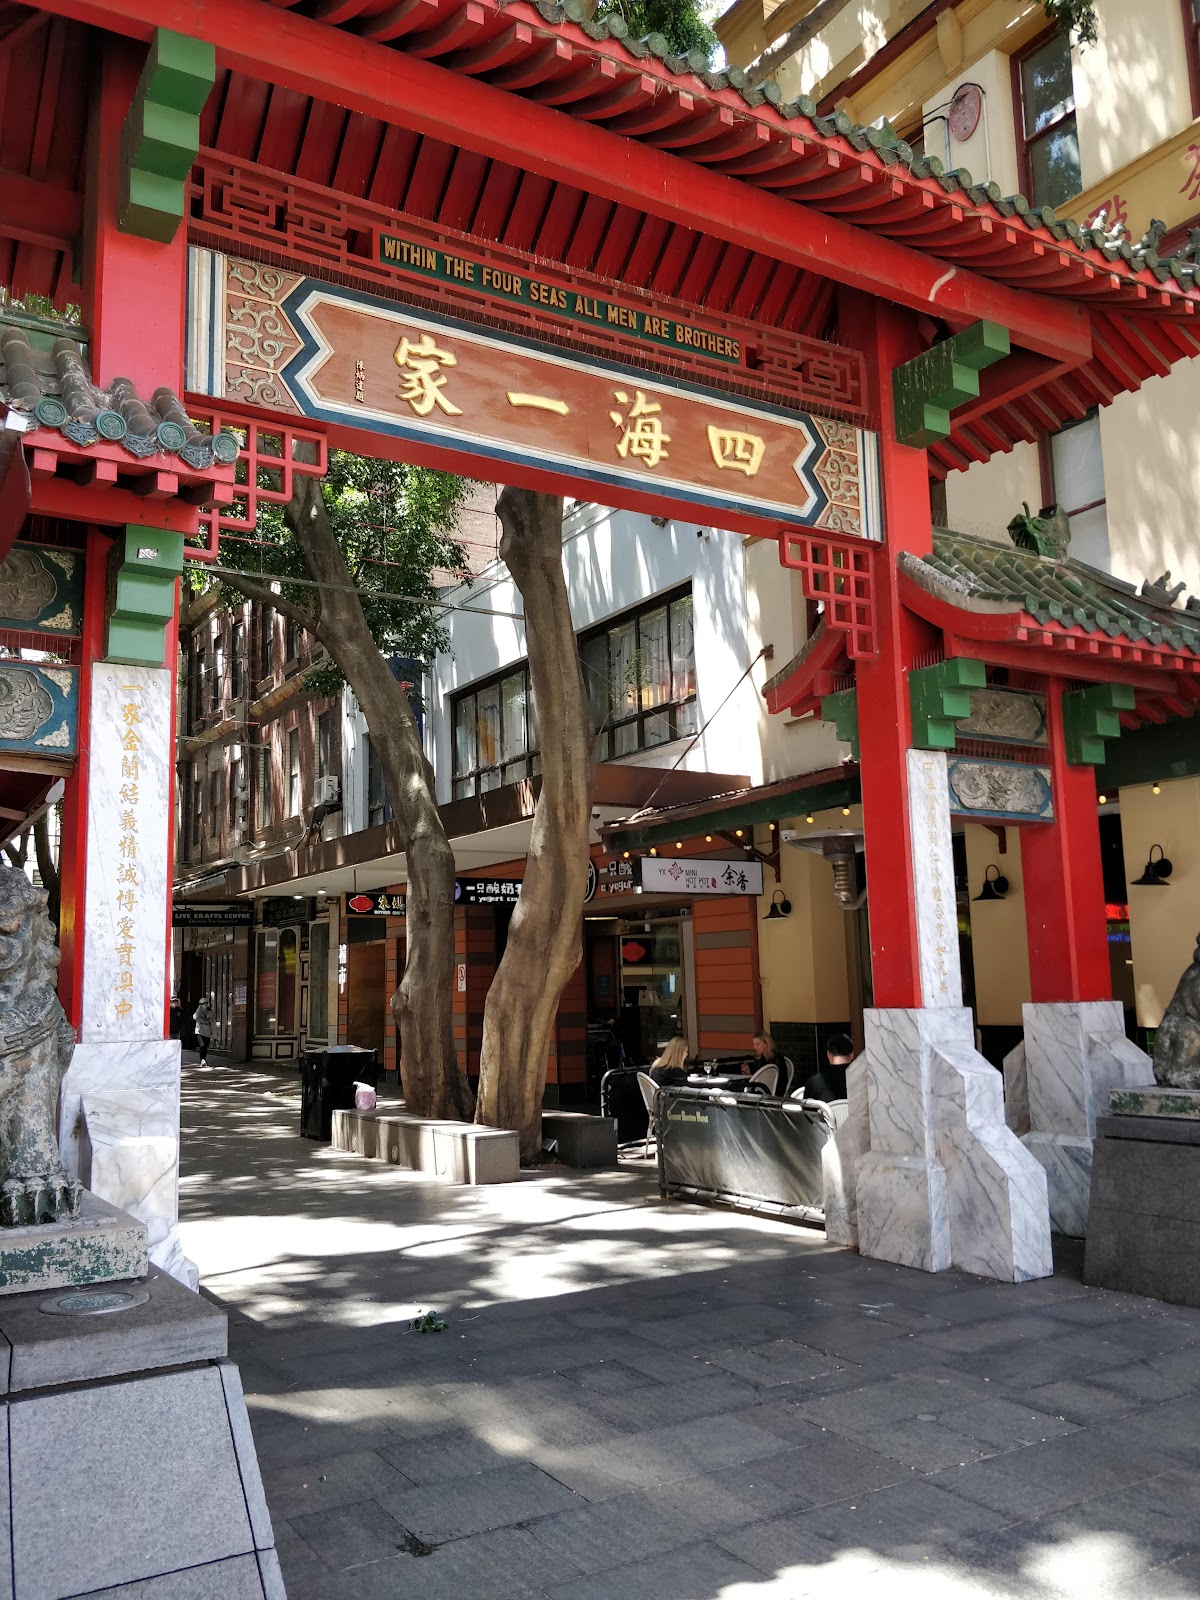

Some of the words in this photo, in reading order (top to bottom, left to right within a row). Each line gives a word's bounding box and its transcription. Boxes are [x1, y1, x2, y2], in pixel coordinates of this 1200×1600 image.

[384, 237, 437, 271] WITHIN
[443, 255, 475, 282] THE
[482, 266, 522, 296] FOUR
[529, 282, 567, 309] SEAS
[575, 295, 602, 319] ALL
[607, 304, 637, 330] MEN
[644, 315, 670, 339] ARE
[675, 324, 740, 359] BROTHERS
[685, 877, 697, 885] HOT
[699, 877, 710, 885] POT
